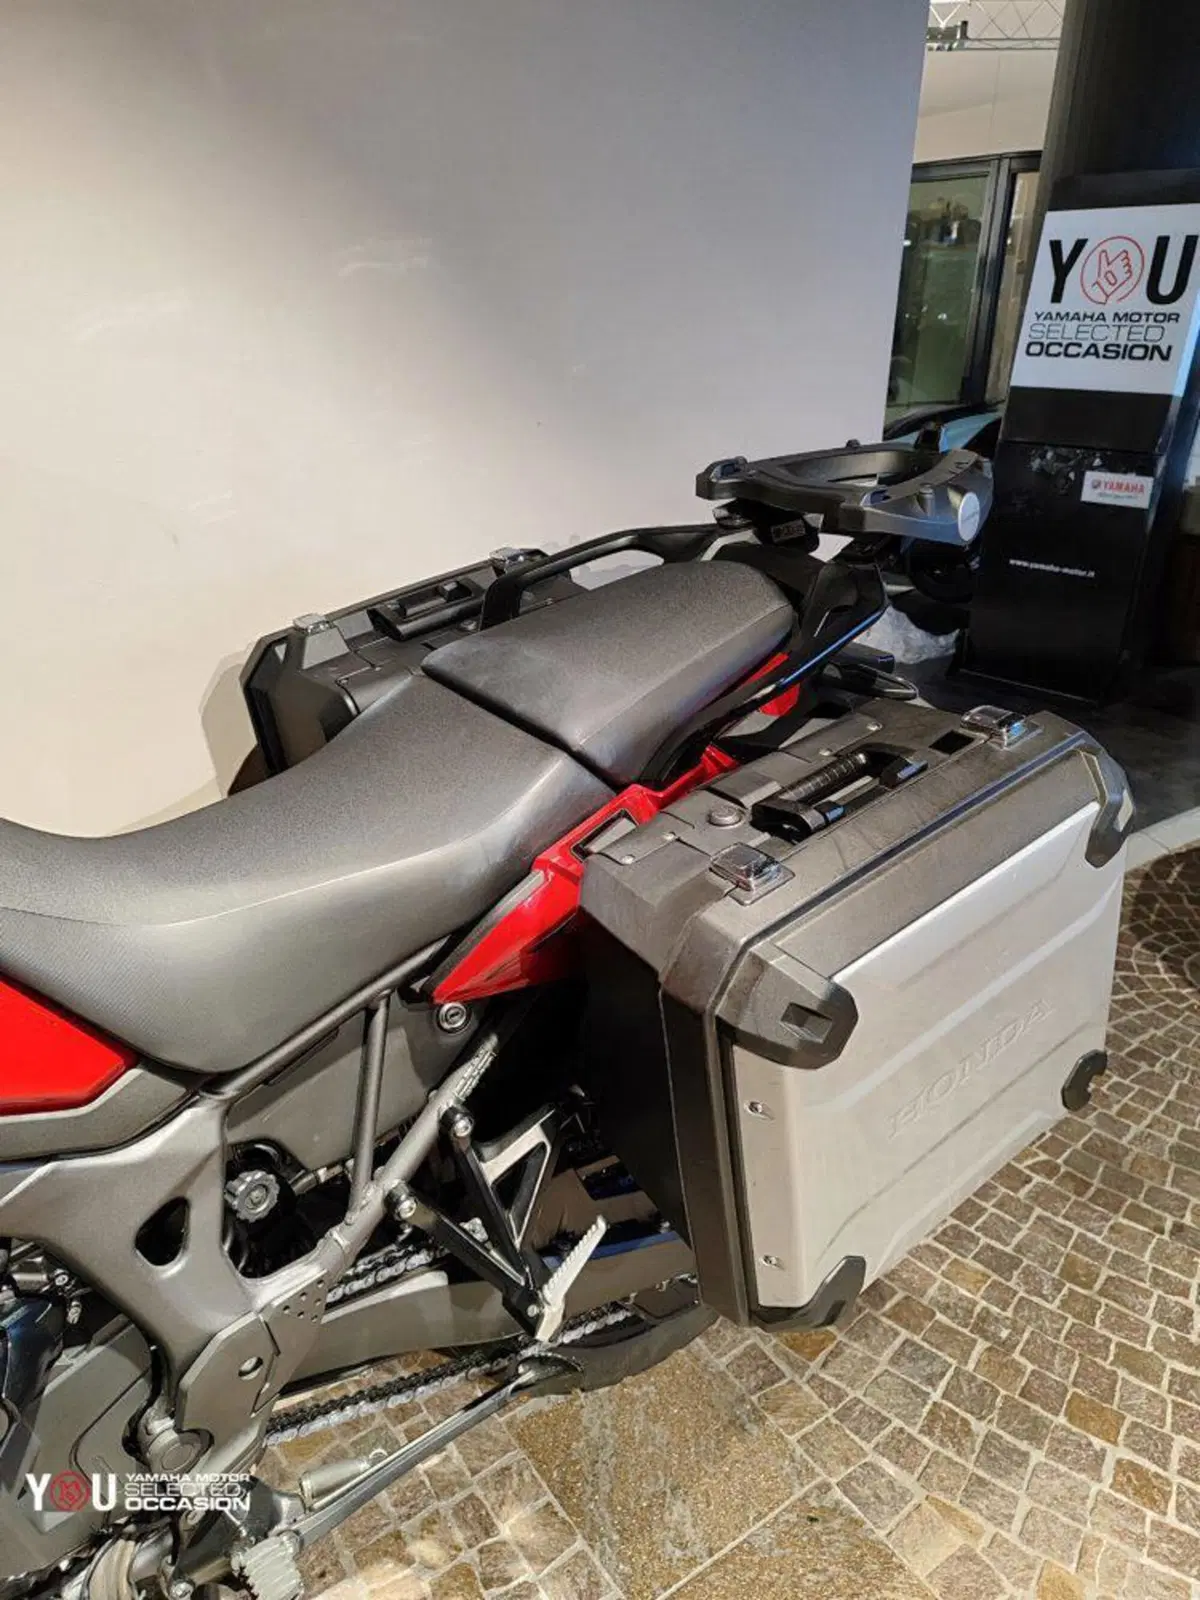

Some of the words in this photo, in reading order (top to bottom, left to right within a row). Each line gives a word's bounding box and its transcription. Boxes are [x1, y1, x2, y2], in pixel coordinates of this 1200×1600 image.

[1034, 311, 1107, 322] YAMAHA
[1112, 312, 1181, 323] MOTOR
[1028, 322, 1166, 343] SELECTED
[1025, 341, 1172, 361] OCCASION
[1103, 480, 1145, 494] YAMAHA
[888, 998, 1056, 1140] HONDA
